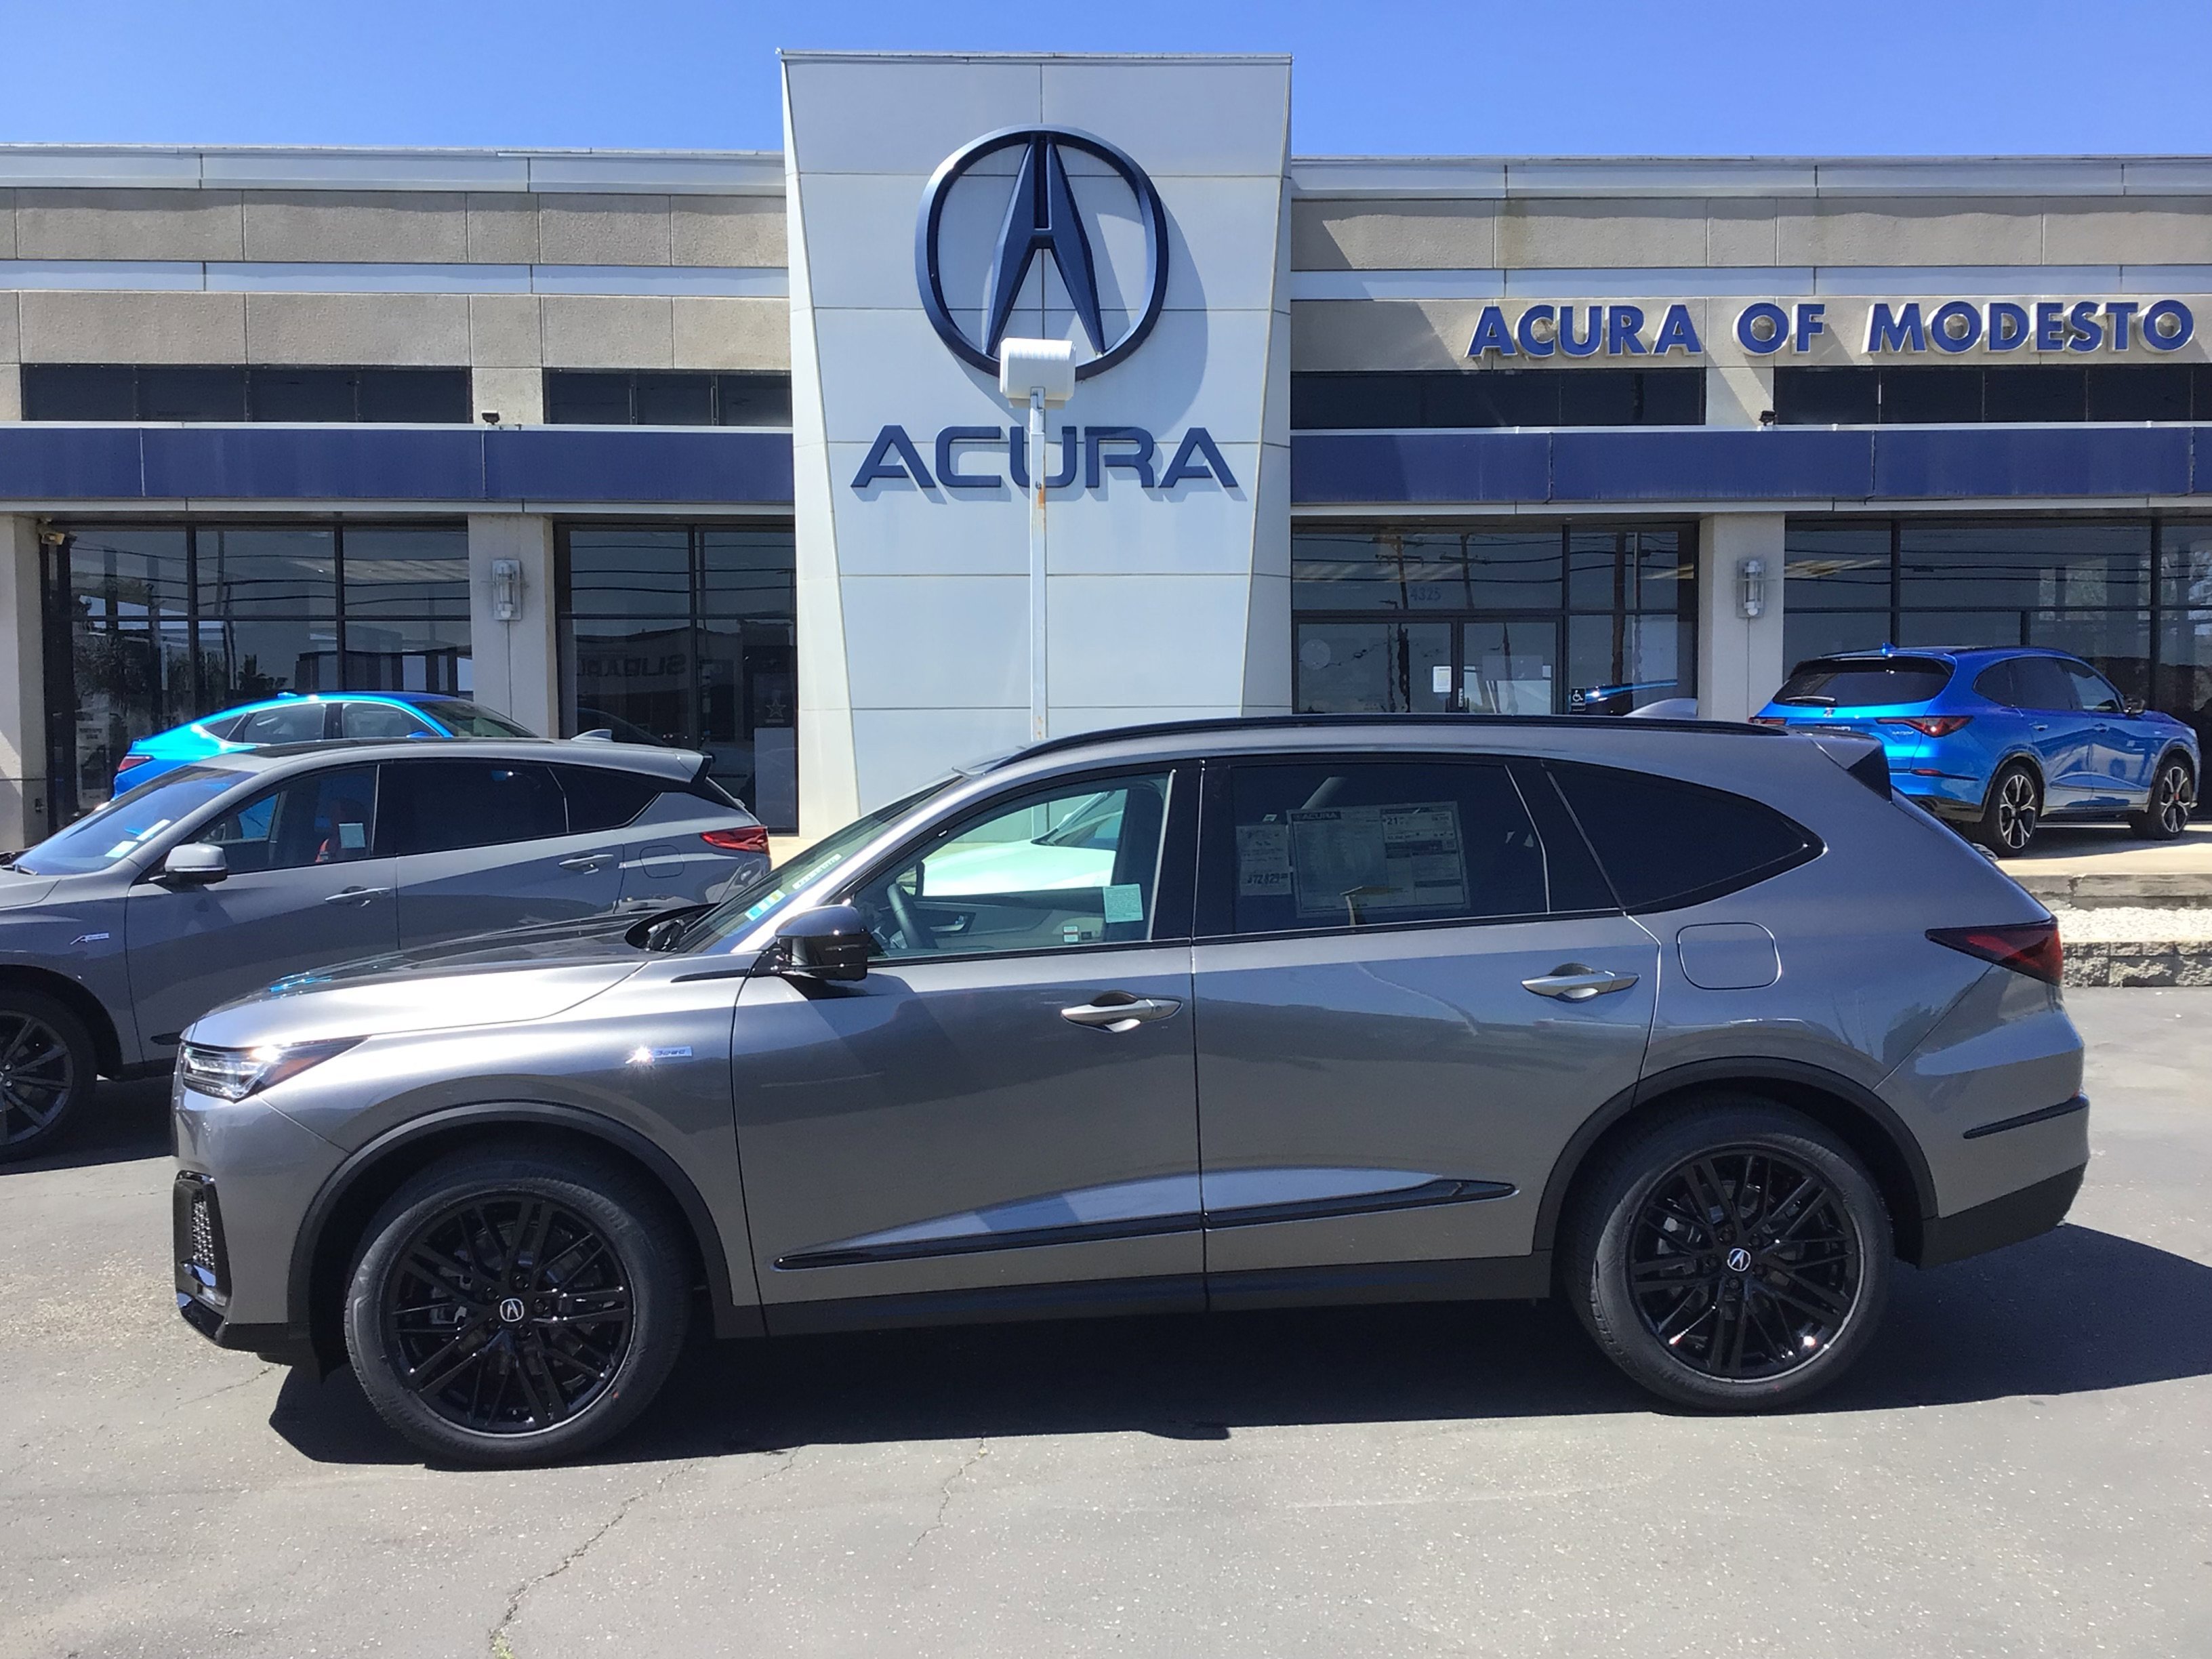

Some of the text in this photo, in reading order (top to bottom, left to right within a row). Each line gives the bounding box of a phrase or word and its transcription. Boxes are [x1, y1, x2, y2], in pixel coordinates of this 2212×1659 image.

[1465, 299, 2194, 358] ACURA OF MODESTO
[851, 424, 1239, 488] ACURA
